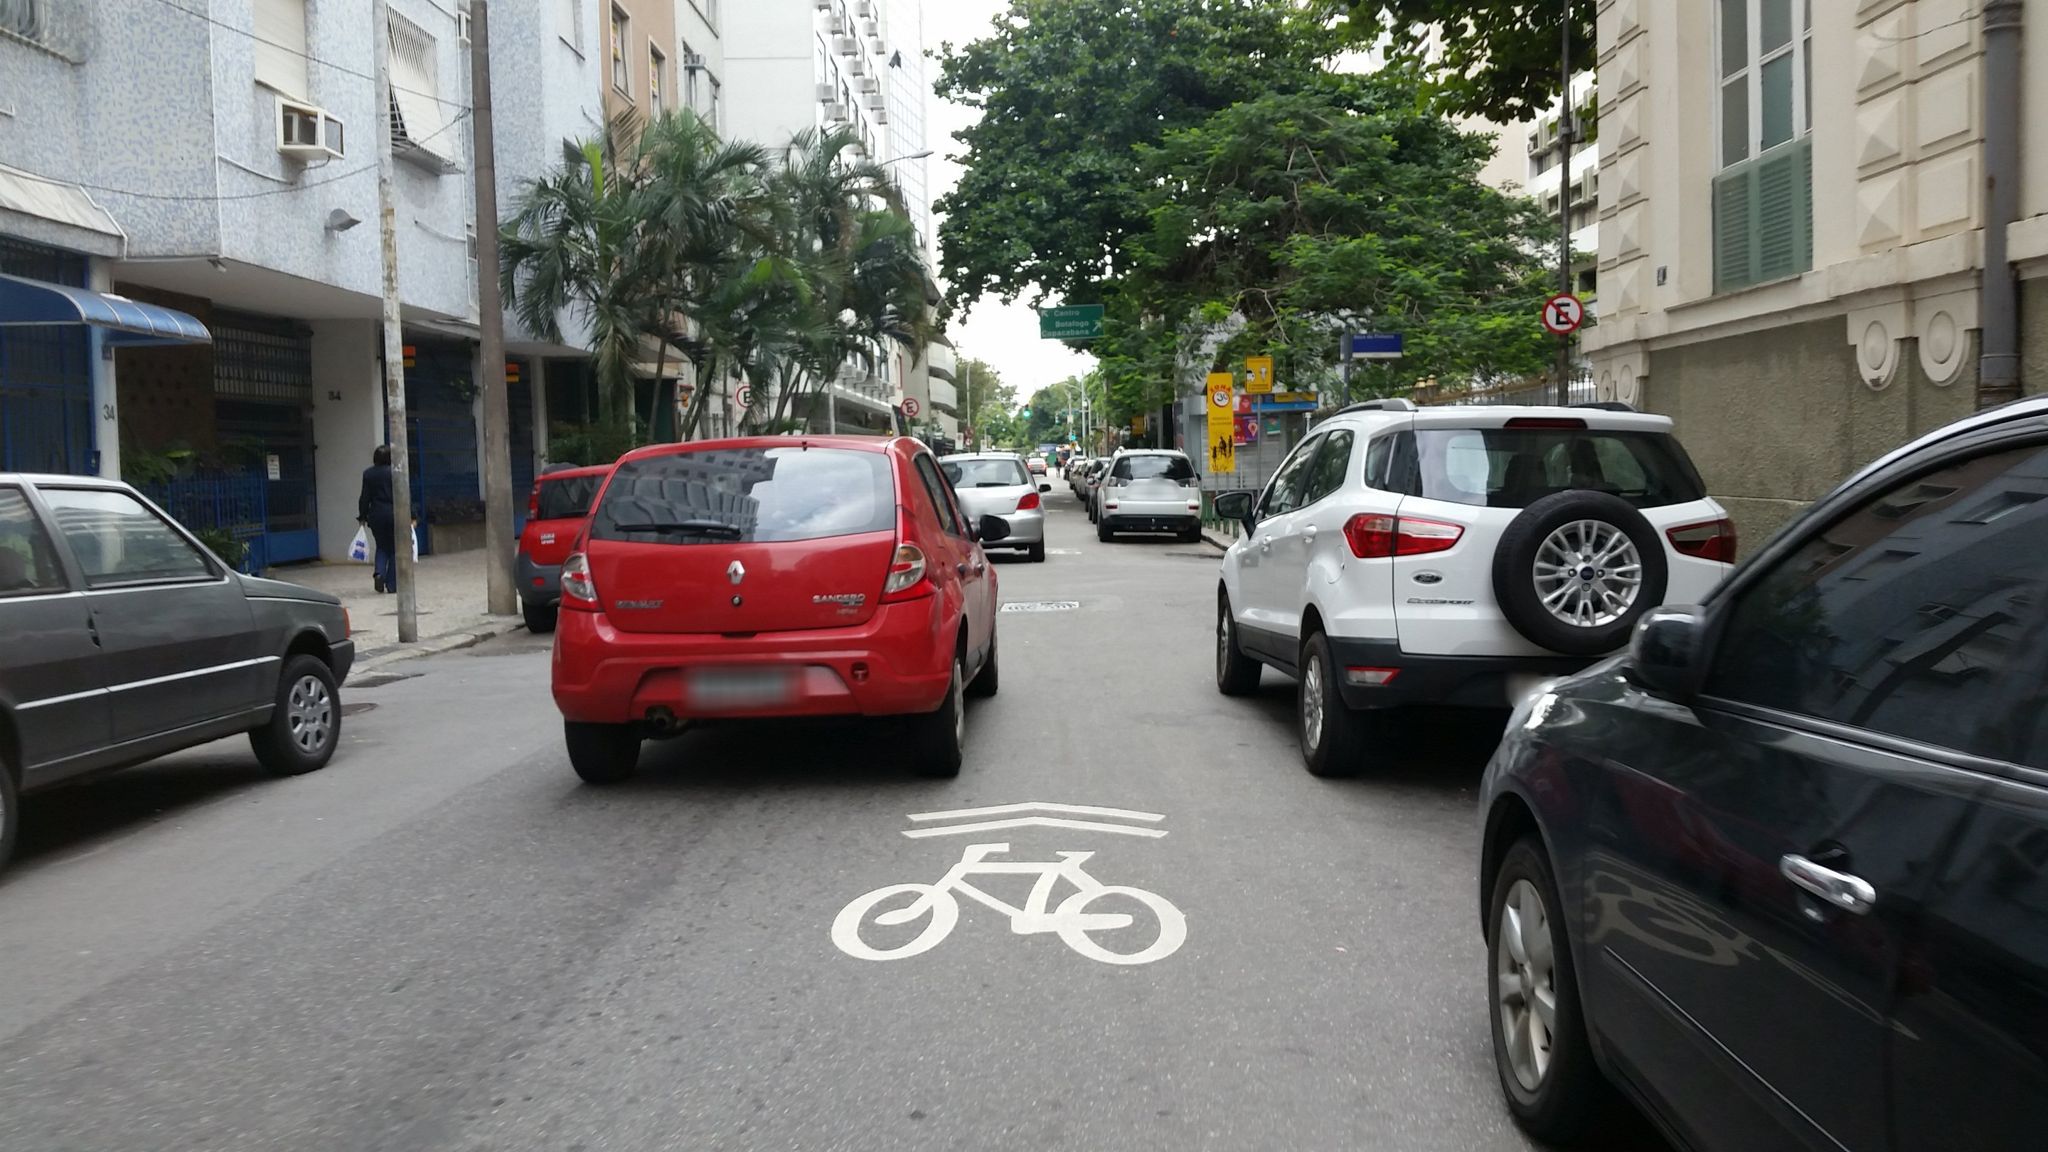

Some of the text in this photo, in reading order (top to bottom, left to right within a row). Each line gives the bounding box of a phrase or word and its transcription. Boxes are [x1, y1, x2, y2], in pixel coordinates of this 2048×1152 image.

[1556, 302, 1571, 325] E
[1055, 320, 1089, 328] Botafogo
[1041, 329, 1090, 337] Copacabana
[743, 391, 753, 404] E
[104, 404, 115, 420] 34
[813, 593, 866, 603] SANDERO
